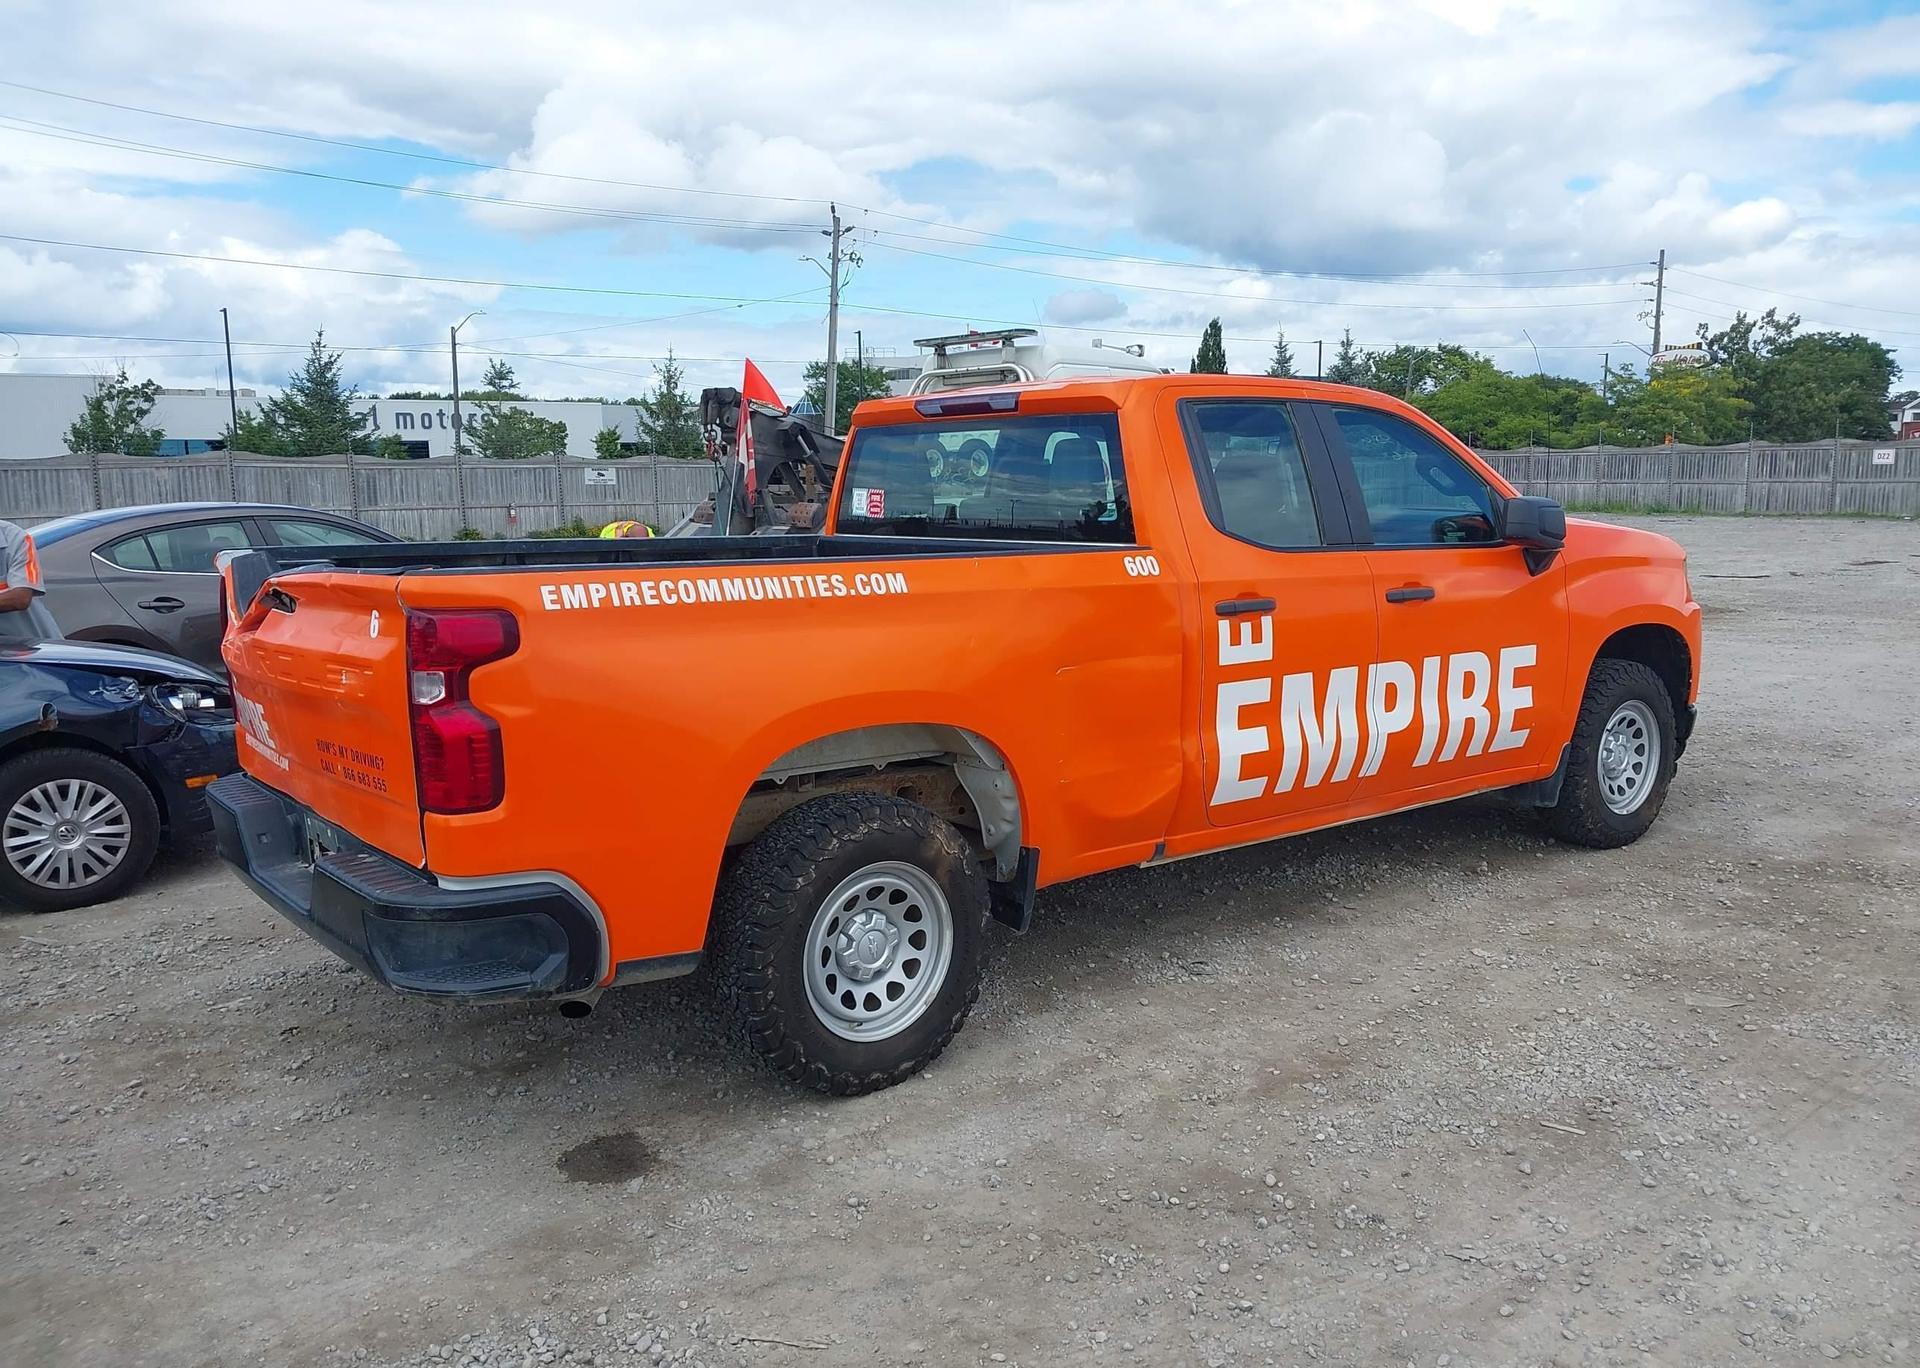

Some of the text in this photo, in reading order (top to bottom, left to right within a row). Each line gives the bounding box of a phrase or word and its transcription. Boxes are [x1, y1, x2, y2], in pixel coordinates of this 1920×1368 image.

[1123, 555, 1160, 577] 600
[539, 572, 909, 611] EMPIRECOMMUNITIES.COM
[370, 609, 379, 639] 6
[1209, 644, 1537, 807] EMPIRE
[316, 738, 385, 772] HOW'S MY DRIVING?
[320, 758, 337, 775] CALL
